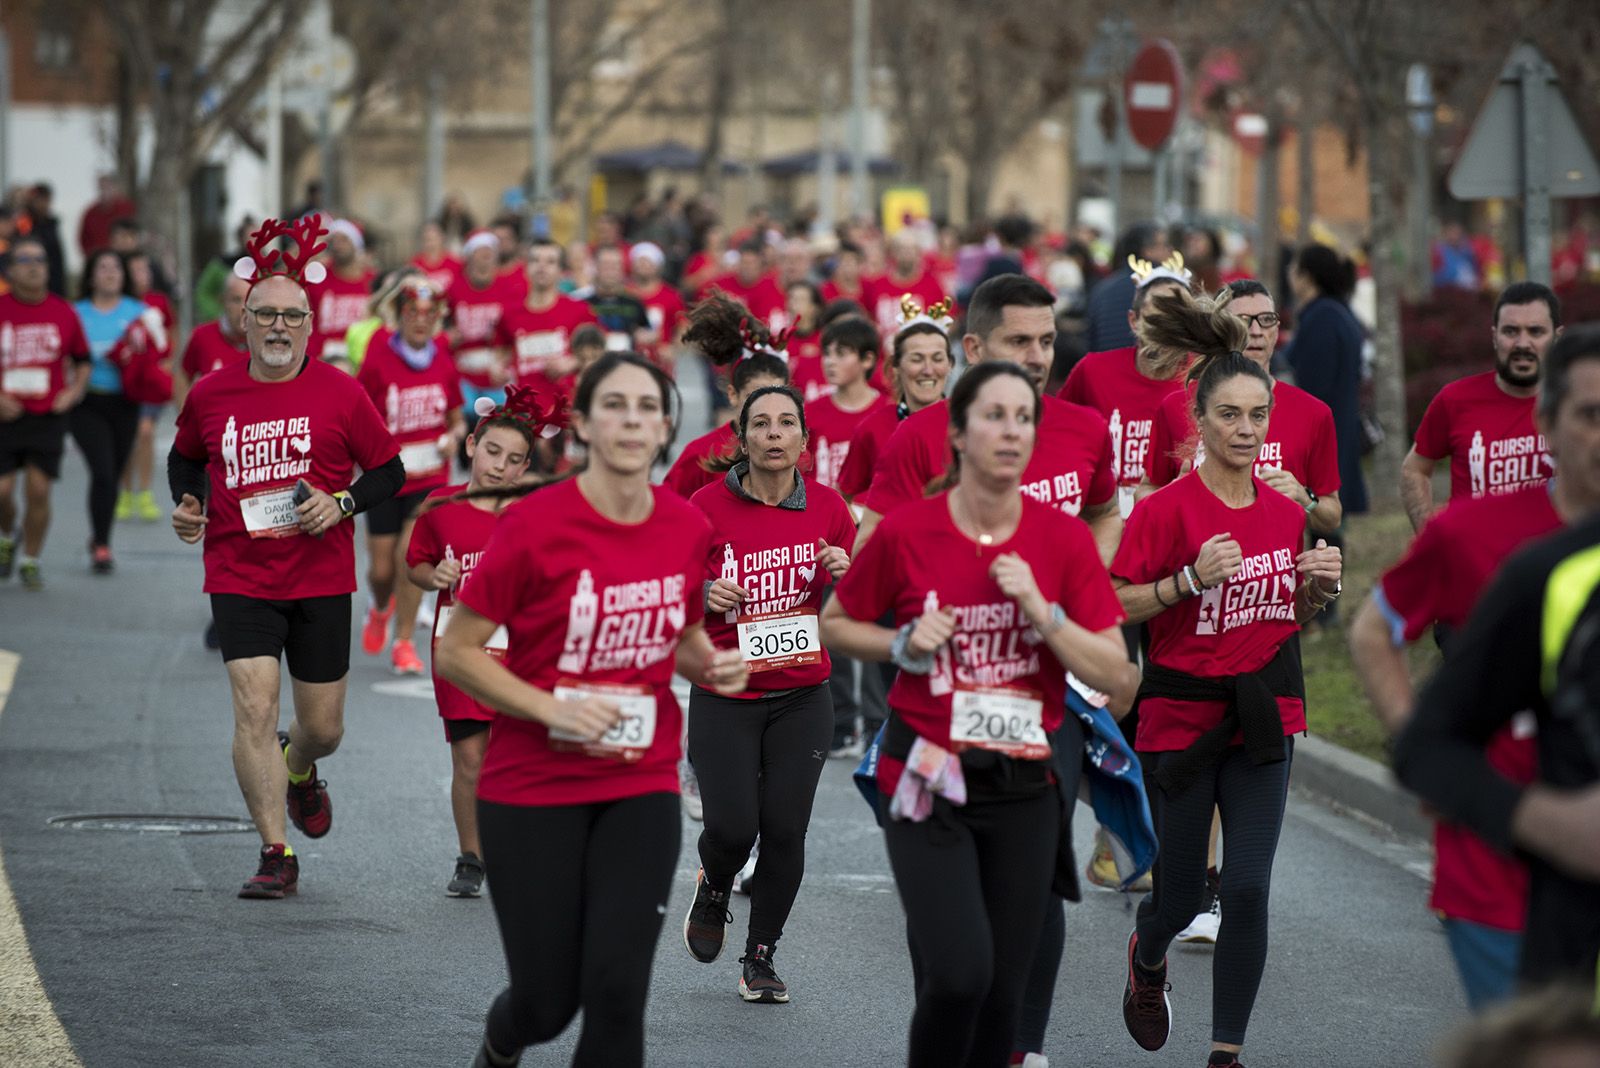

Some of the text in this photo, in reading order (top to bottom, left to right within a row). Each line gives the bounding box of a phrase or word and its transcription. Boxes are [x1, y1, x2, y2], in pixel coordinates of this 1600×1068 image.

[241, 416, 311, 443] CURSA DEL
[1126, 420, 1152, 439] CUR
[240, 437, 292, 469] GALL
[1259, 442, 1283, 462] DEL
[1490, 435, 1535, 459] CURSA
[241, 458, 312, 486] SANT CUGAT
[1488, 453, 1543, 485] GALL
[1053, 471, 1082, 500] DEL
[264, 501, 296, 515] DAVID
[271, 513, 293, 525] 445
[743, 542, 816, 573] CURSA DEL
[1273, 547, 1296, 572] DEL
[602, 578, 662, 615] CURSA
[743, 566, 800, 603] GALL
[1225, 574, 1283, 613] GALL
[595, 606, 667, 651] GALL
[1222, 601, 1295, 634] SANT CUGA
[749, 628, 809, 657] 3056
[952, 629, 1022, 667] GALL
